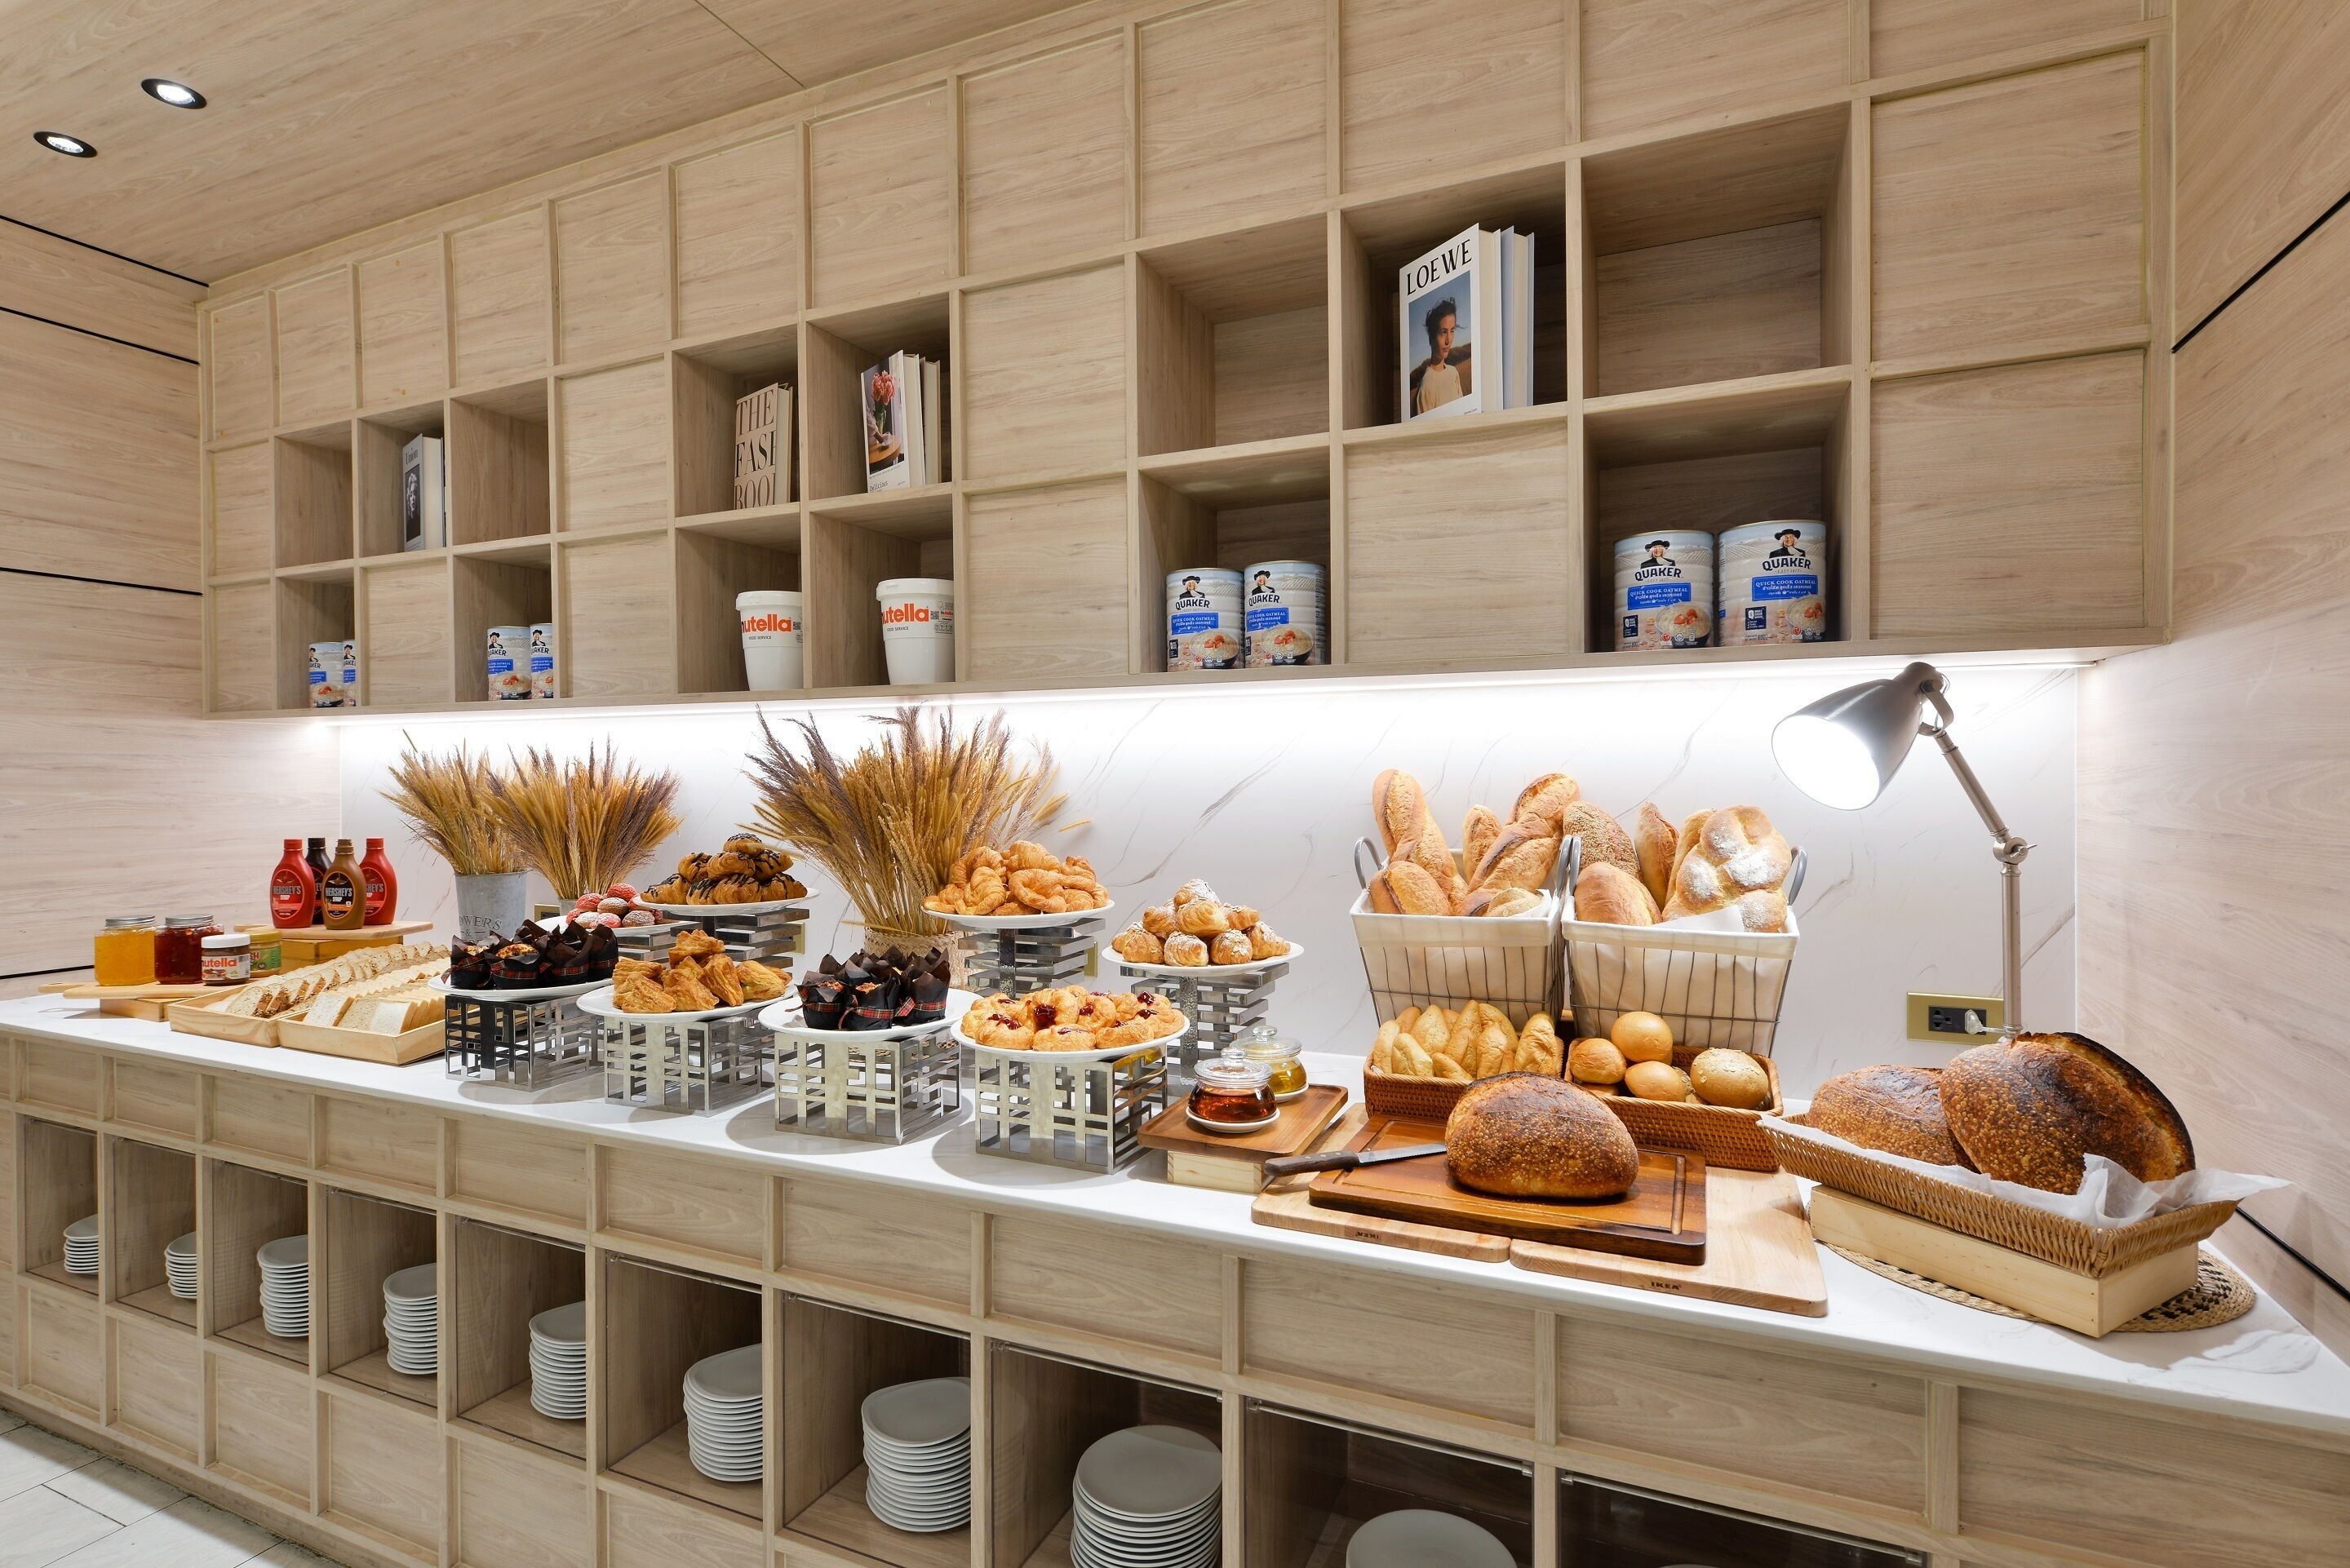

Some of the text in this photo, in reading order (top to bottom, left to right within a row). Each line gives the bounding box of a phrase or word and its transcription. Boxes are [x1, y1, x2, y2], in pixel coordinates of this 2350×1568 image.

[1407, 238, 1472, 295] LOEWE
[737, 390, 774, 436] THE
[1762, 557, 1811, 571] QUAKER
[1634, 568, 1682, 581] QUAKER
[1175, 599, 1209, 610] QUAKER
[1249, 594, 1279, 606] QUAKER
[273, 885, 301, 895] HERSHEY'S
[325, 888, 352, 897] HERSHEY'S
[465, 928, 472, 937] &
[1651, 1281, 1679, 1290] IKEA
